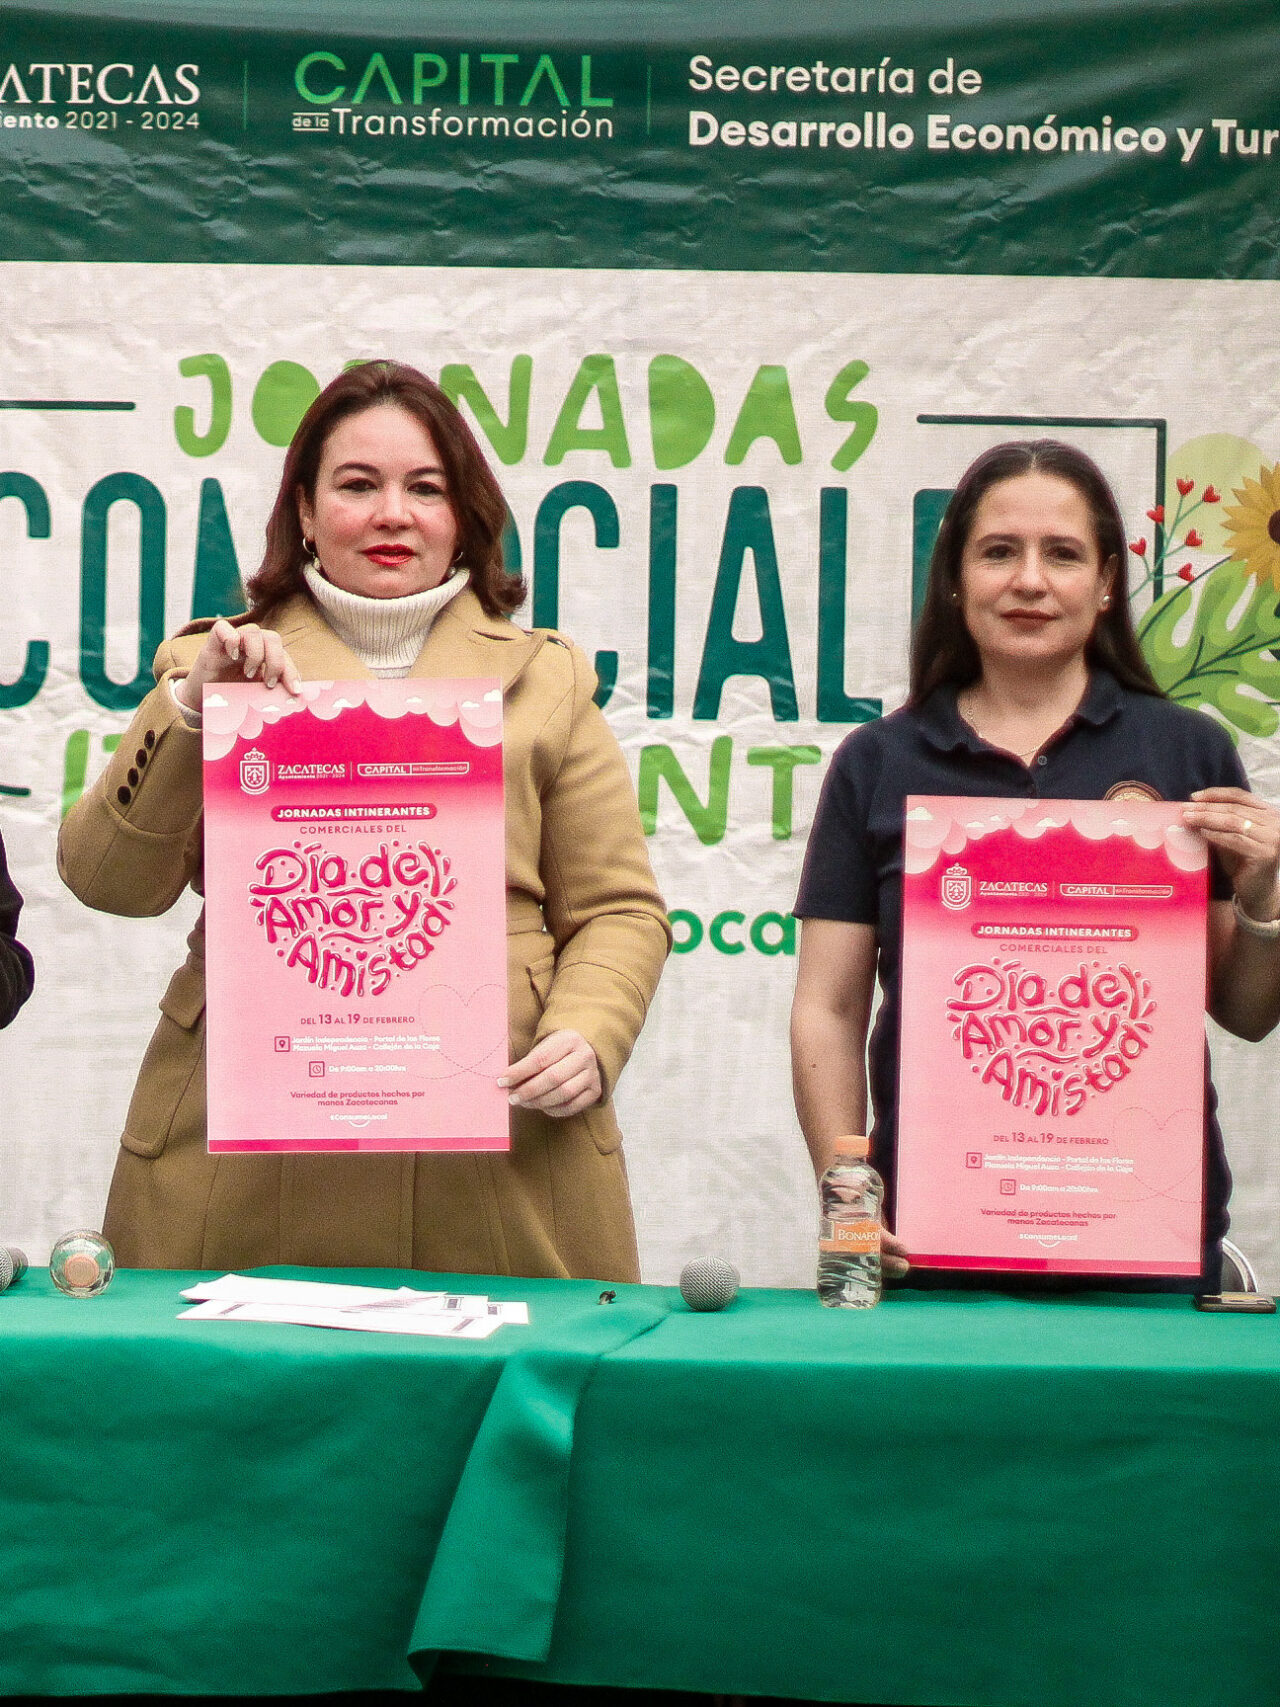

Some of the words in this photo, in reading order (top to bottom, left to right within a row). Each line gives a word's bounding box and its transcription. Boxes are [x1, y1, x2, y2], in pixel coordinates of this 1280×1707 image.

[294, 50, 614, 107] CAPITAL
[690, 56, 915, 95] Secretaría
[929, 58, 983, 95] de
[66, 112, 118, 131] 2021
[142, 112, 200, 131] 2024
[293, 116, 311, 127] de
[314, 116, 329, 127] la
[331, 108, 614, 138] Transformación
[690, 111, 915, 150] Desarrollo
[928, 115, 1168, 154] Económico
[1176, 127, 1204, 163] y
[1211, 118, 1280, 154] Tur
[174, 353, 878, 471] JONADAS
[277, 763, 345, 774] ZACATECAS
[364, 765, 406, 774] CAPITAL
[277, 807, 341, 818] JORNADAS
[344, 806, 430, 817] INTINERANTES
[299, 824, 383, 834] COMERCIALES
[386, 824, 407, 833] DEL
[249, 841, 348, 895] Día
[358, 840, 440, 898] del
[979, 880, 1047, 892] ZACATECAS
[1066, 885, 1109, 895] CAPITAL
[261, 893, 384, 944] Amor
[977, 925, 1042, 936] JORNADAS
[1044, 926, 1131, 938] INTINERANTES
[285, 898, 452, 997] Amistad
[999, 943, 1083, 954] COMERCIALES
[1086, 945, 1108, 954] DEL
[947, 958, 1047, 1013] Día
[1056, 961, 1140, 1020] del
[318, 1013, 332, 1024] 13
[347, 1013, 360, 1024] 19
[957, 1010, 1081, 1063] Amor
[980, 1017, 1149, 1118] Amistad
[290, 1090, 327, 1098] Variedad
[327, 1090, 338, 1098] de
[339, 1090, 380, 1099] productos
[345, 1098, 398, 1106] Zacatecanas
[993, 1134, 1009, 1142] DEL
[1011, 1131, 1025, 1142] 13
[1026, 1135, 1038, 1143] AL
[1040, 1132, 1054, 1143] 19
[1056, 1136, 1067, 1144] DE
[1069, 1137, 1109, 1145] FEBRERO
